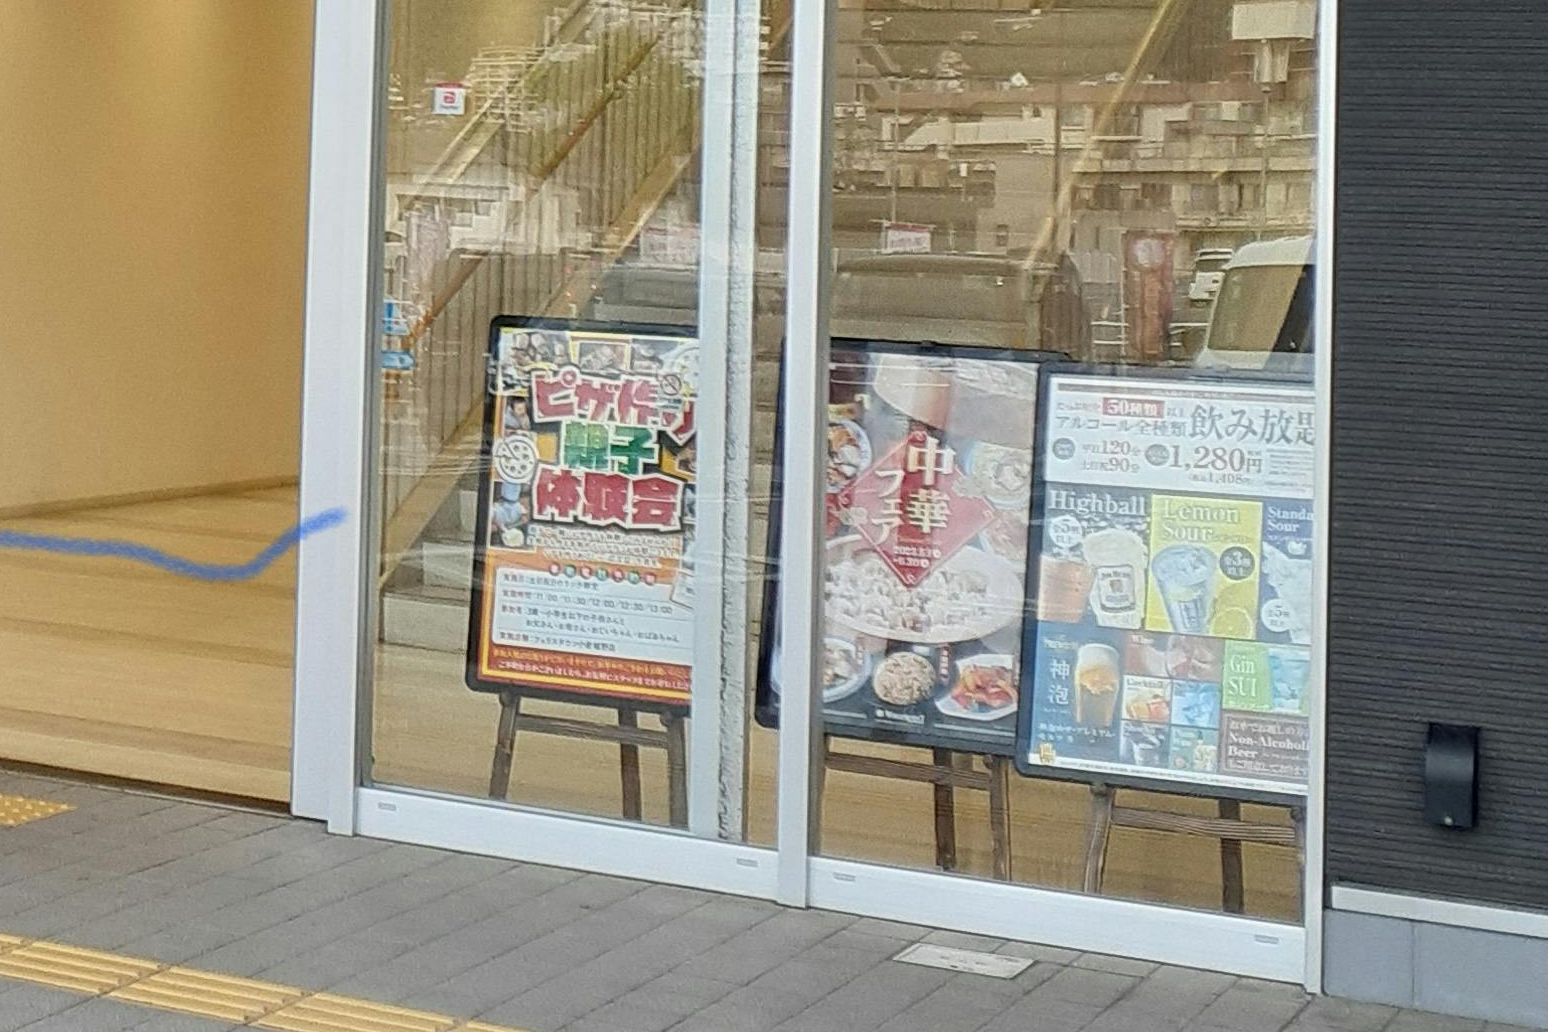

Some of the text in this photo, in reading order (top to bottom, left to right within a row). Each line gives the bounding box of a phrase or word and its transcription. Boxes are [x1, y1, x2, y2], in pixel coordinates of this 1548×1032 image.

[1055, 416, 1187, 437] アルコール全種類
[562, 421, 660, 475] 親子
[1169, 444, 1262, 473] 1,280円
[906, 435, 956, 534] 中華
[532, 464, 684, 531] 体験会
[871, 469, 905, 545] フェア
[1048, 489, 1147, 515] Highball
[1163, 499, 1240, 523] Lemon
[1162, 519, 1213, 542] Sour
[1267, 519, 1300, 534] Sour
[1230, 654, 1256, 674] Gin
[1049, 658, 1071, 706] 神泡
[1228, 676, 1257, 697] SUI
[1227, 745, 1258, 759] Beer
